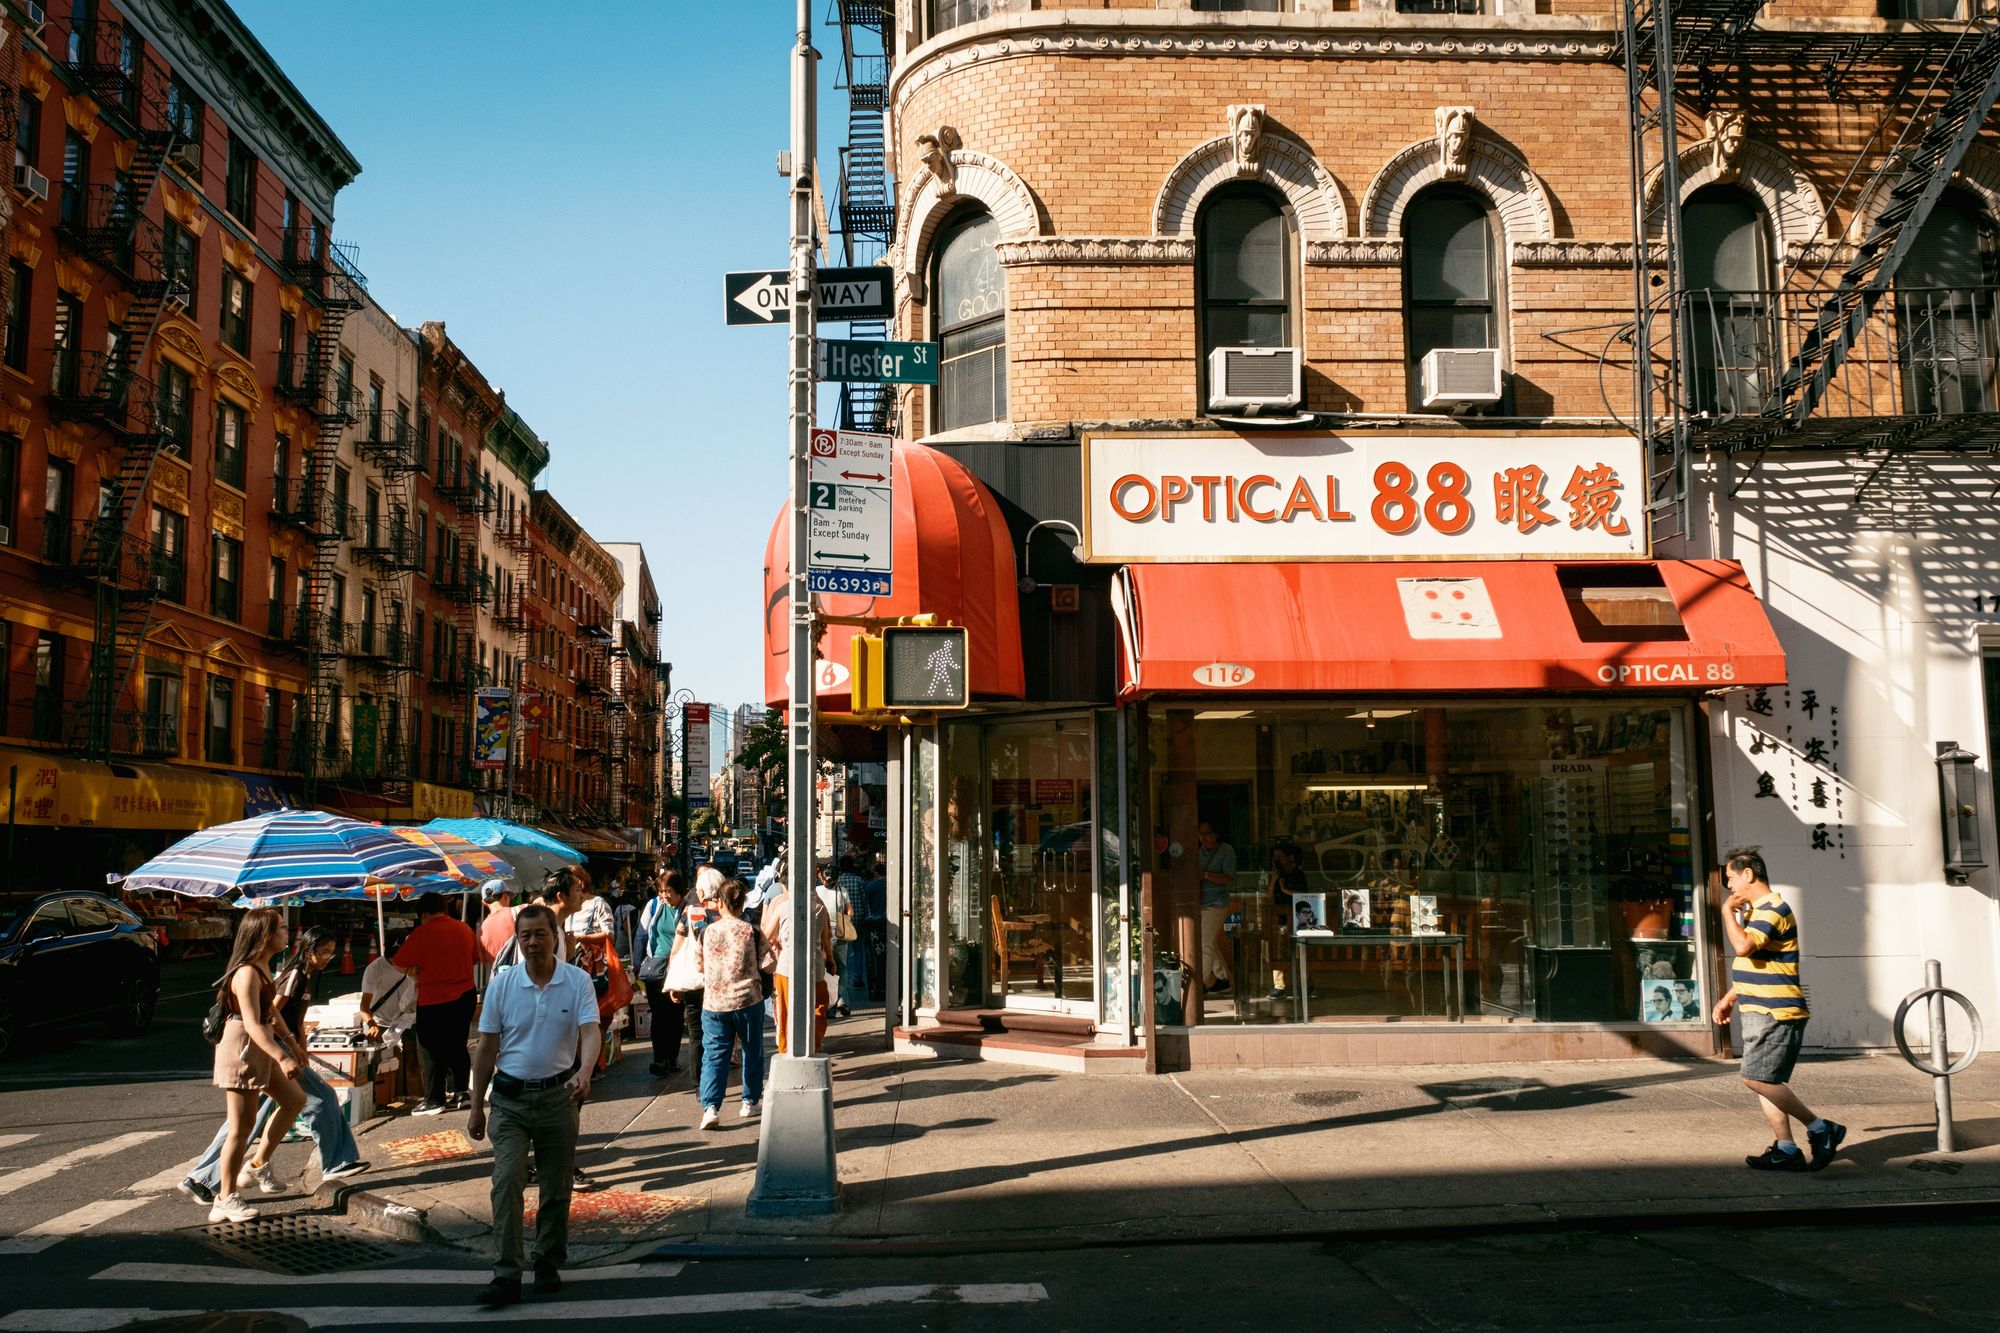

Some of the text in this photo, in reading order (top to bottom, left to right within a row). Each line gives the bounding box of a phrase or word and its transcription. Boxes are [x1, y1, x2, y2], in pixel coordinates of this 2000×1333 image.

[757, 283, 870, 308] ON WAY
[832, 345, 928, 378] Hester St
[839, 437, 863, 448] 7:30am
[868, 440, 883, 449] 8am
[839, 448, 885, 460] Except Sunday
[816, 485, 829, 507] 2
[838, 488, 854, 496] hour
[1109, 460, 1631, 535] OPTICAL 88 眼鏡
[838, 496, 866, 505] metered
[838, 504, 863, 514] parking
[813, 518, 830, 527] 8am
[838, 519, 854, 529] 7pm
[813, 528, 870, 541] Except Sunday
[811, 575, 871, 593] 106393
[1204, 665, 1244, 684] 116
[1597, 662, 1735, 682] OPTICAL 88
[1551, 763, 1594, 774] PRADA
